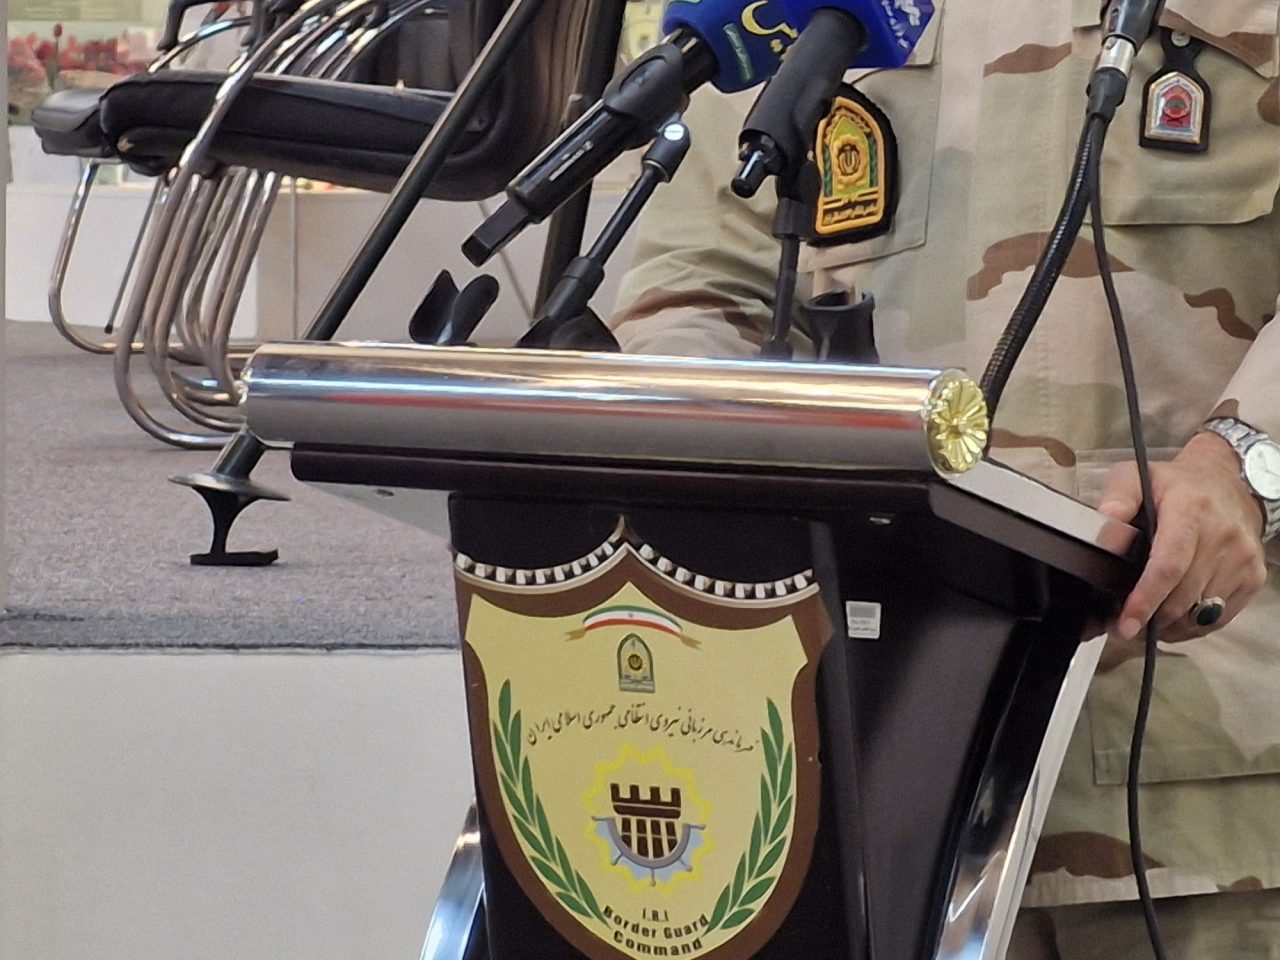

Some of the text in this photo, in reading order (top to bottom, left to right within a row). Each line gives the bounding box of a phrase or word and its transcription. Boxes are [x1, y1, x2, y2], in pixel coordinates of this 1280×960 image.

[527, 716, 554, 747] ایران
[552, 711, 582, 734] اسلامی
[649, 705, 682, 737] نیروی
[680, 707, 714, 743] مرزبانی
[603, 905, 709, 939] Border Guard
[613, 930, 703, 956] Command
